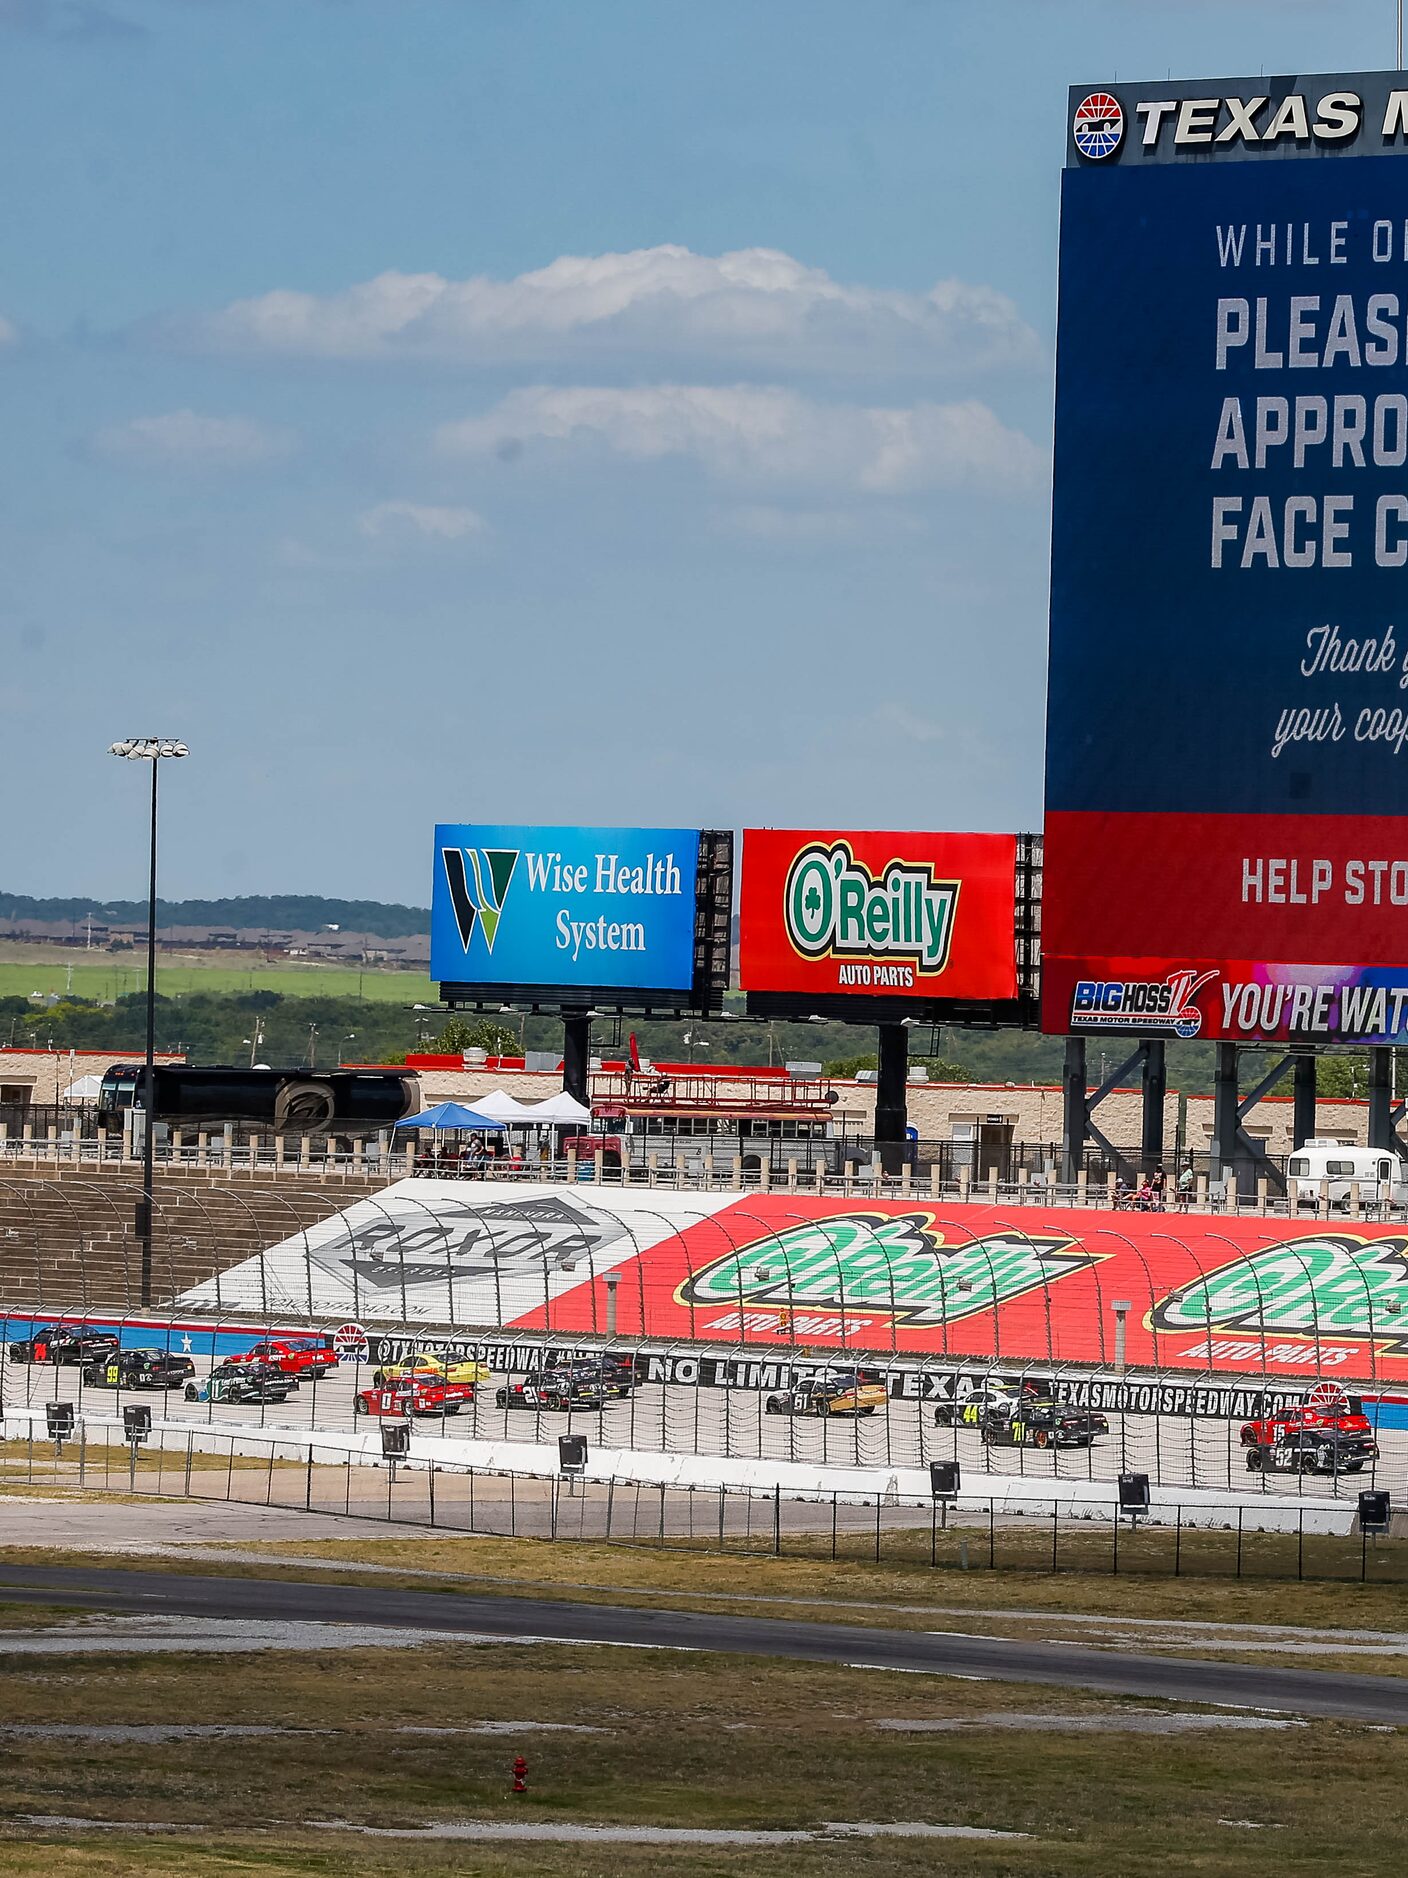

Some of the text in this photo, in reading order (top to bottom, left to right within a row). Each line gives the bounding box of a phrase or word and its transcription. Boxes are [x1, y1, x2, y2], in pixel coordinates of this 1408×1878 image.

[1135, 92, 1361, 146] TEXAS
[1216, 222, 1349, 267] WHILE
[1211, 495, 1354, 568] FACE
[1300, 625, 1397, 676] Thank
[1271, 702, 1345, 757] your
[525, 852, 682, 896] Wise Health
[1241, 858, 1332, 904] HELP
[792, 855, 949, 961] O'Reilly
[555, 909, 646, 963] System
[838, 964, 914, 988] AUTO PARTS
[1072, 1015, 1175, 1025] TEXAS MOTOR SPEEDWAY
[1220, 982, 1329, 1032] YOU'RE
[332, 1224, 608, 1264] ROXOR
[702, 1312, 771, 1332] AUTO
[107, 1365, 119, 1383] 99
[647, 1357, 698, 1383] NO
[1176, 1340, 1359, 1366] AUTO PARTS
[963, 1404, 978, 1423] 44
[1273, 1424, 1286, 1442] 15
[1275, 1447, 1293, 1467] 52
